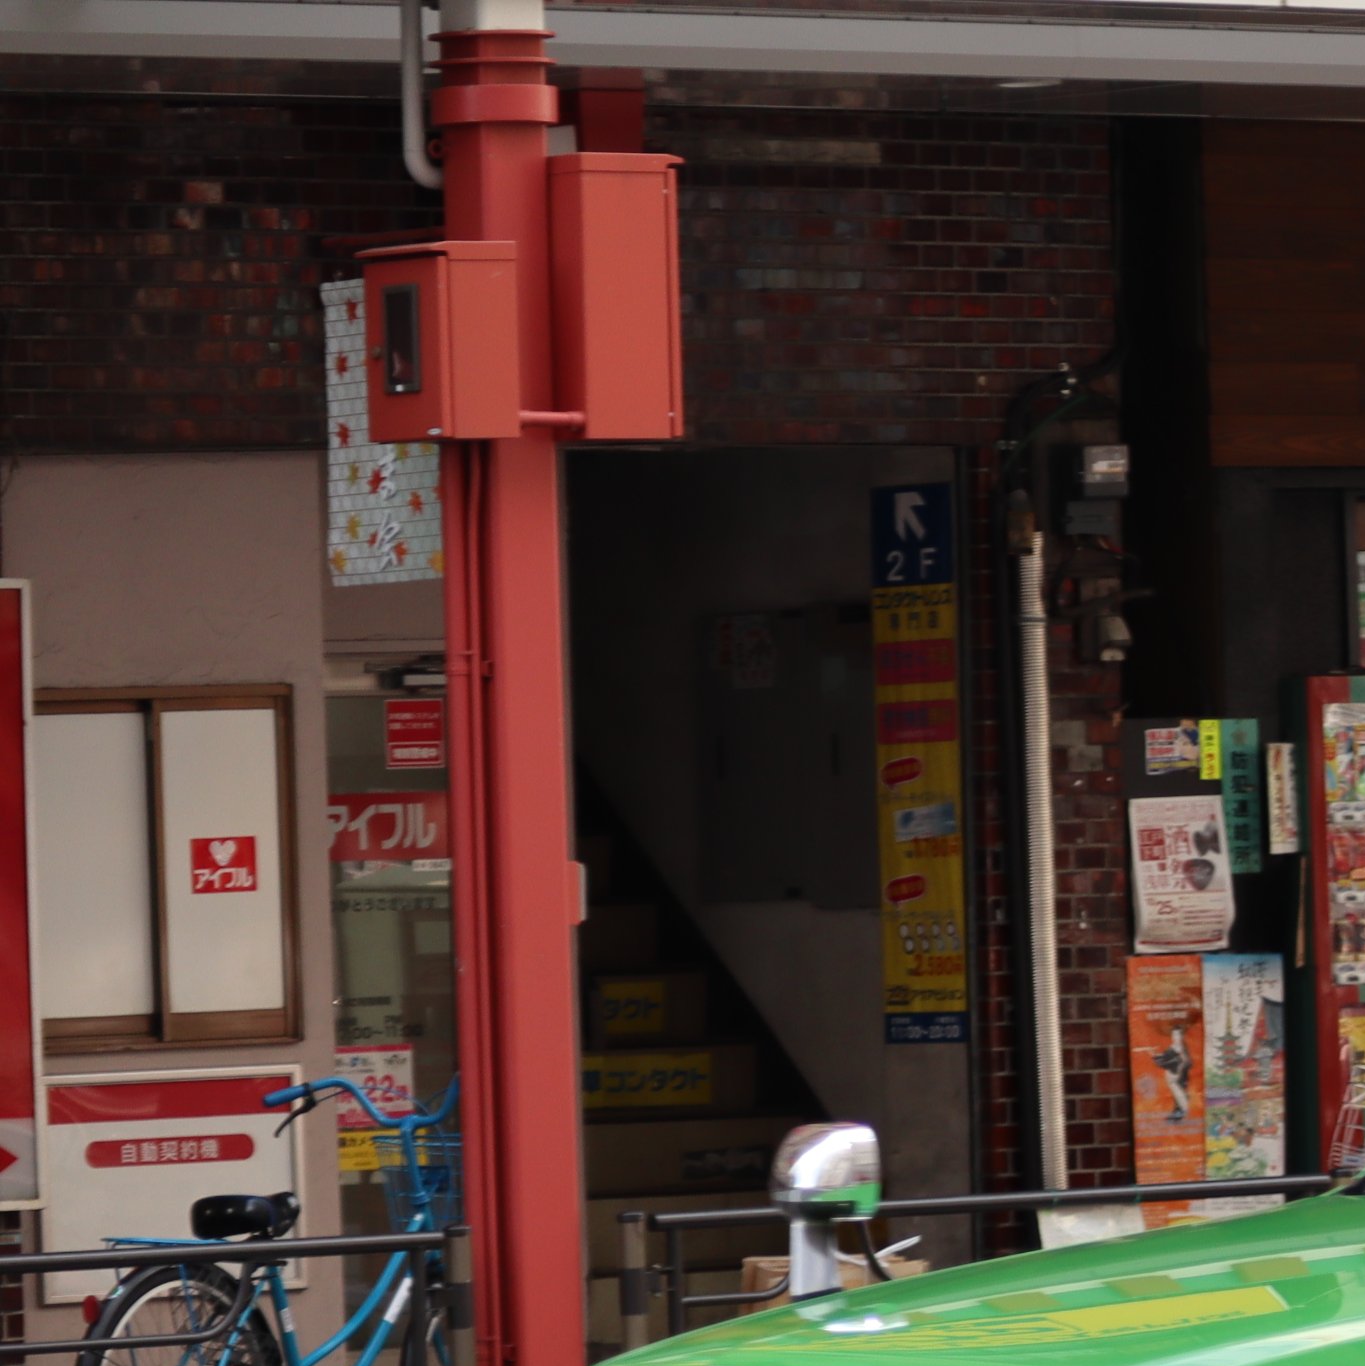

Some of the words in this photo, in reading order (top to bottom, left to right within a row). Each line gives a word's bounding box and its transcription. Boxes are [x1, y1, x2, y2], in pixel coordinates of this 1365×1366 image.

[326, 802, 438, 851] アイフル
[193, 867, 252, 889] アイフル
[120, 1140, 219, 1163] 自動契約機
